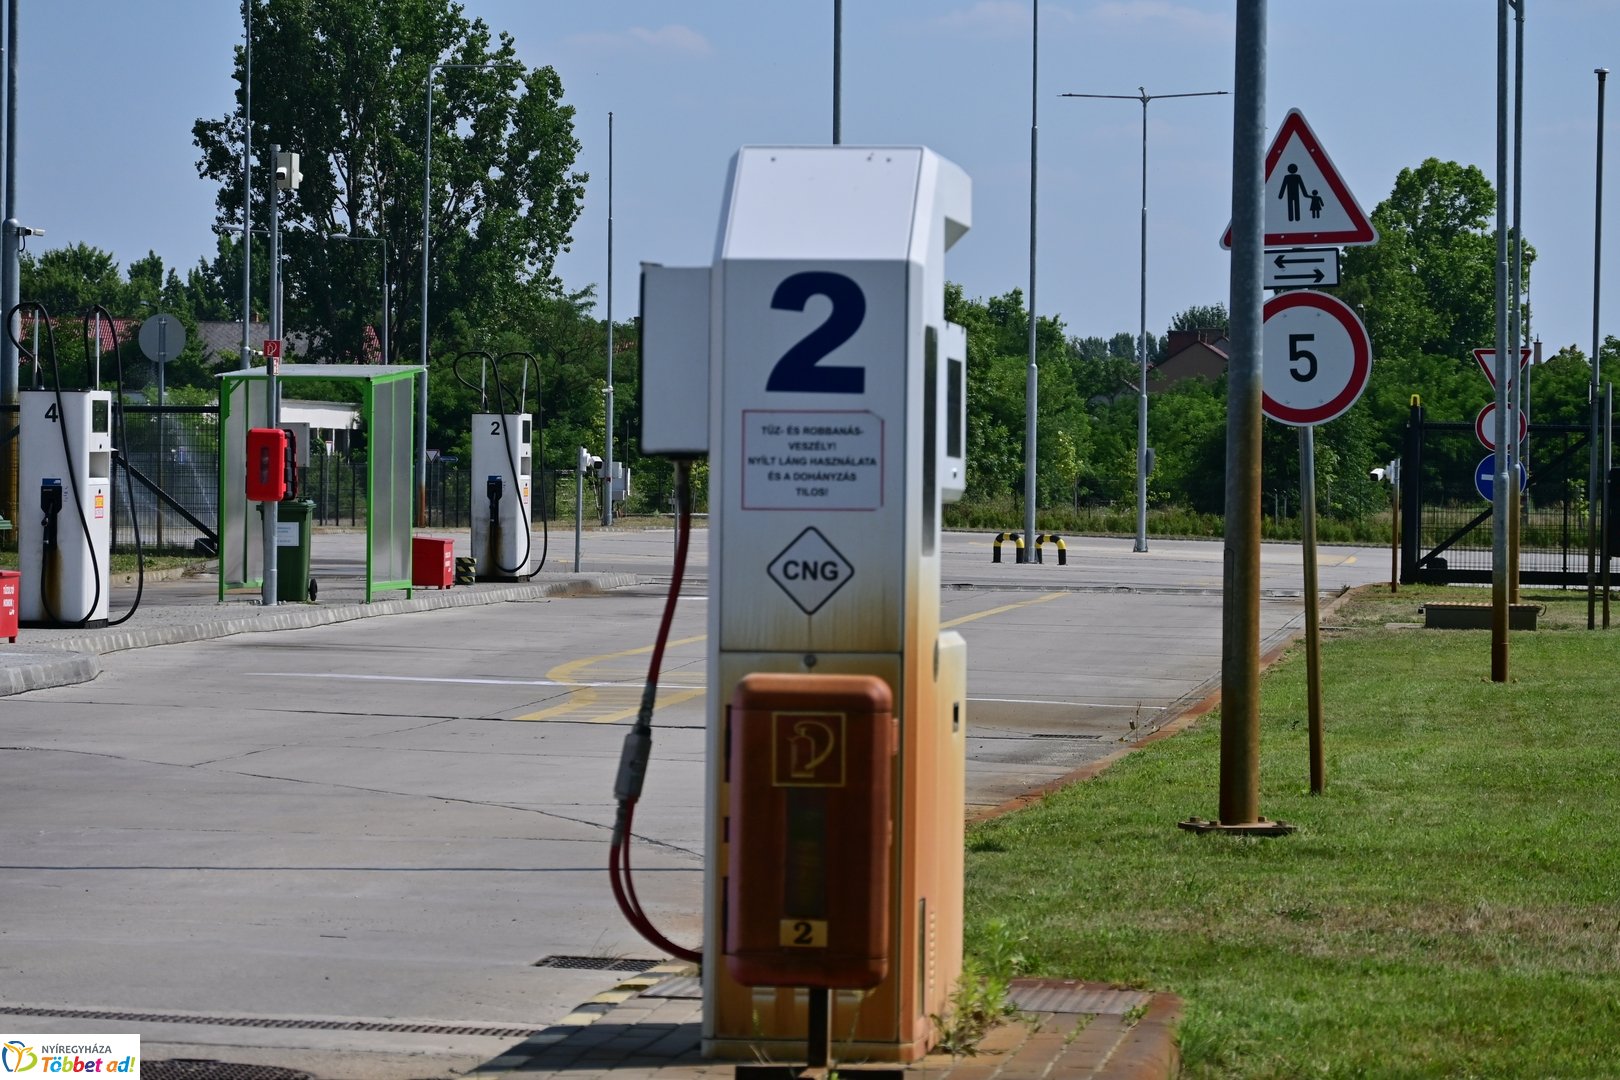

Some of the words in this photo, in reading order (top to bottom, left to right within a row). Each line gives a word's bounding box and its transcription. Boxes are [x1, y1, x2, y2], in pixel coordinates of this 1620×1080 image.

[766, 271, 866, 394] 2
[1289, 333, 1318, 382] 5
[45, 403, 59, 423] 4
[490, 421, 501, 436] 2
[787, 424, 800, 436] ÉS
[803, 424, 864, 436] ROBBANÁS-
[788, 441, 837, 451] VESZÉLY!
[748, 456, 776, 466] NYÍLT
[779, 456, 807, 466] LÁNG
[810, 456, 877, 466] HASZNÁLATA
[768, 471, 781, 482] ÉS
[783, 472, 791, 482] A
[793, 471, 857, 482] DOHÁNYZÁS
[795, 487, 829, 497] TILOS!
[782, 560, 839, 582] CNG
[793, 921, 814, 945] 2
